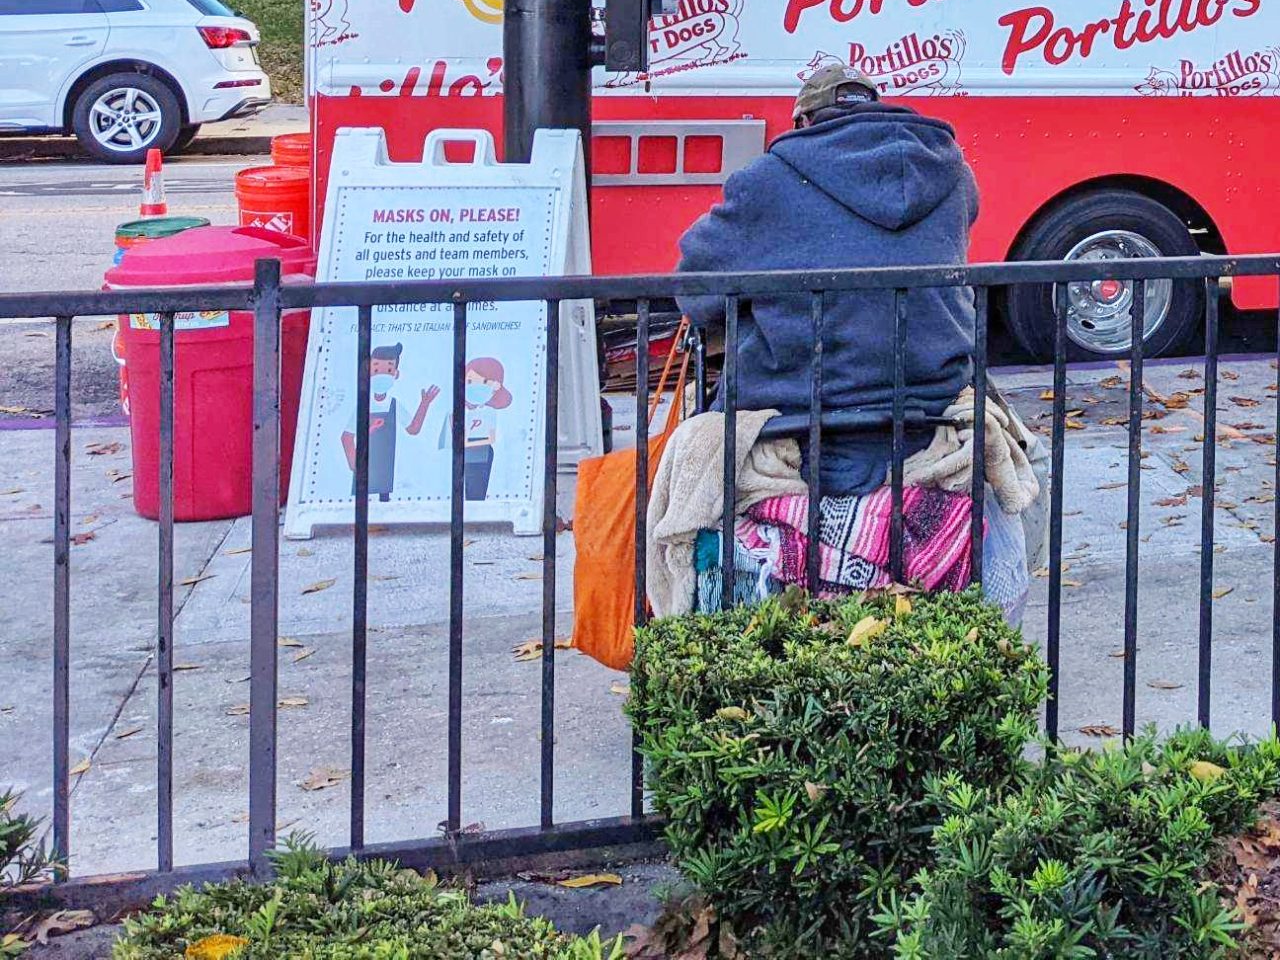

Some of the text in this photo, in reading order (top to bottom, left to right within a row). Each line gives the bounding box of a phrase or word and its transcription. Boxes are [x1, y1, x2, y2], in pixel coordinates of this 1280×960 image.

[664, 18, 716, 49] DOGS
[848, 32, 953, 76] Portillo's
[893, 63, 940, 90] DOGS
[1179, 49, 1272, 89] Portillo's
[372, 208, 521, 225] MASKS ON, PLEASE!
[364, 229, 525, 246] For the health and safety of
[355, 248, 529, 265] all guests and team members,
[365, 265, 517, 280] please keep your mask on
[388, 322, 413, 333] THAT'S
[423, 321, 450, 332] ITALIAN
[471, 320, 522, 331] SANDWICHES!
